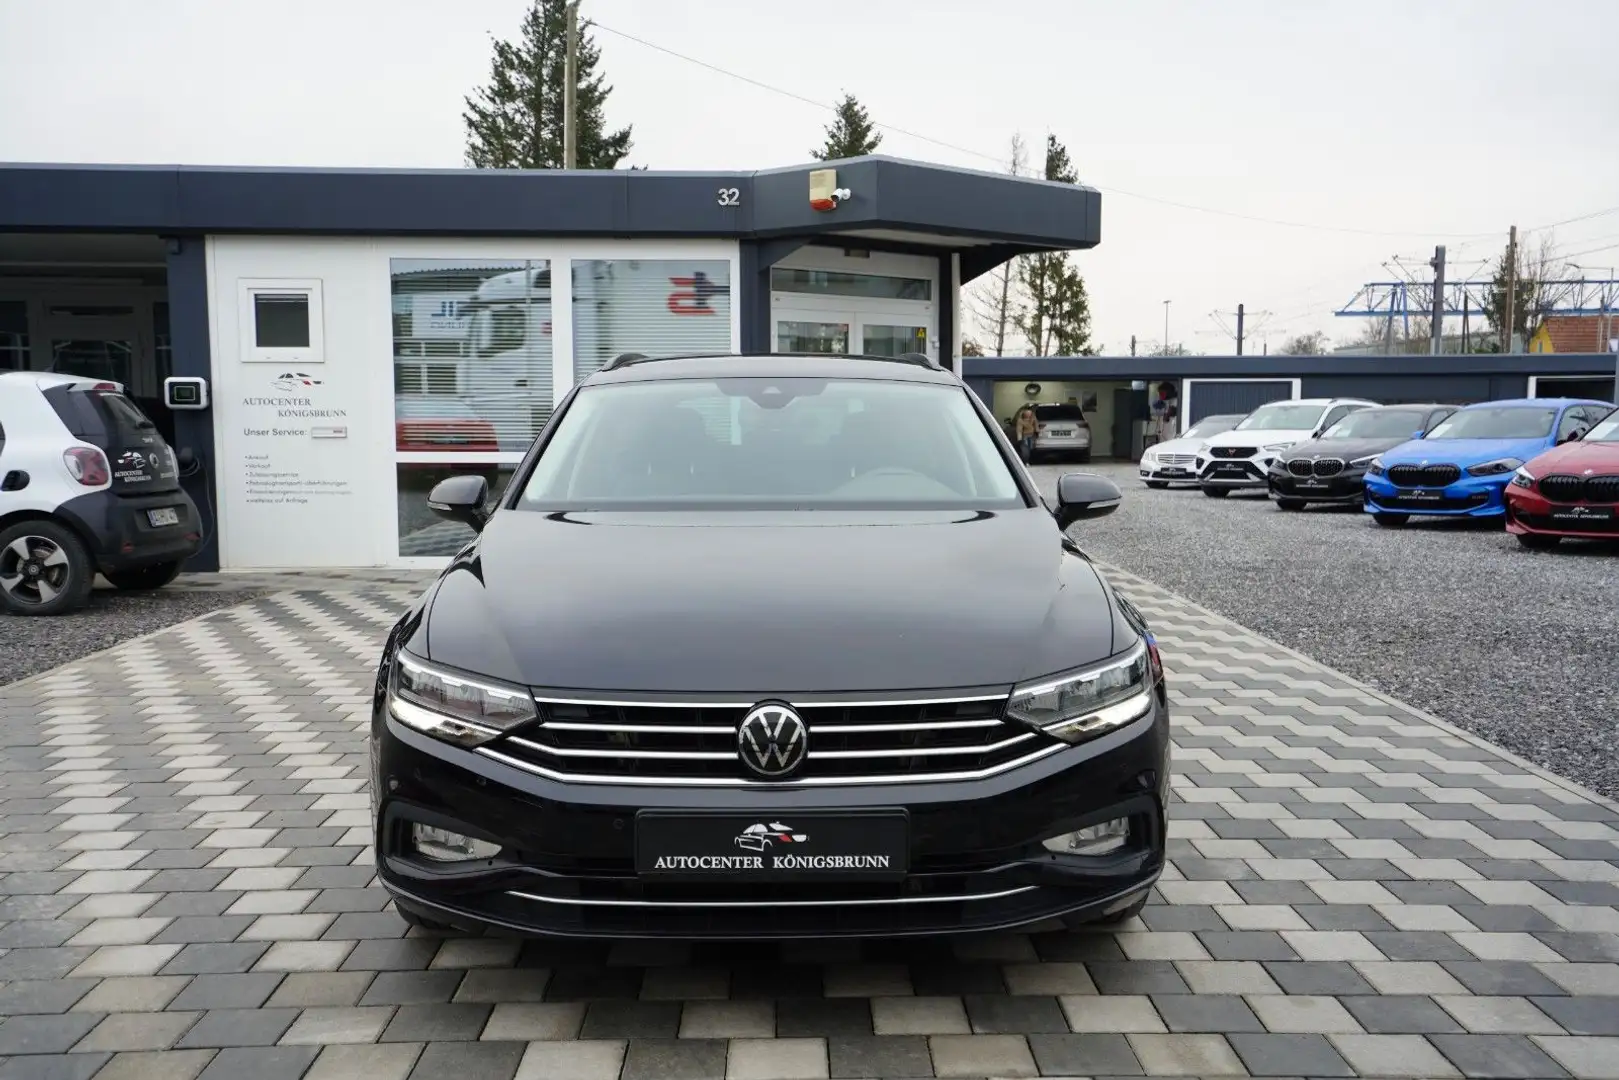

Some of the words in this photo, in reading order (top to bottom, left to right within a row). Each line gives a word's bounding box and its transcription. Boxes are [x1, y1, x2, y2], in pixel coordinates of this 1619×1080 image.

[717, 187, 740, 206] 32
[242, 397, 312, 406] AUTOCENTER
[278, 408, 347, 417] KÖNIGSBRUNN
[243, 428, 269, 436] Unser
[272, 428, 308, 436] Service:
[654, 856, 764, 869] AUTOCENTER
[772, 854, 890, 869] KÖNIGSBRUNN
